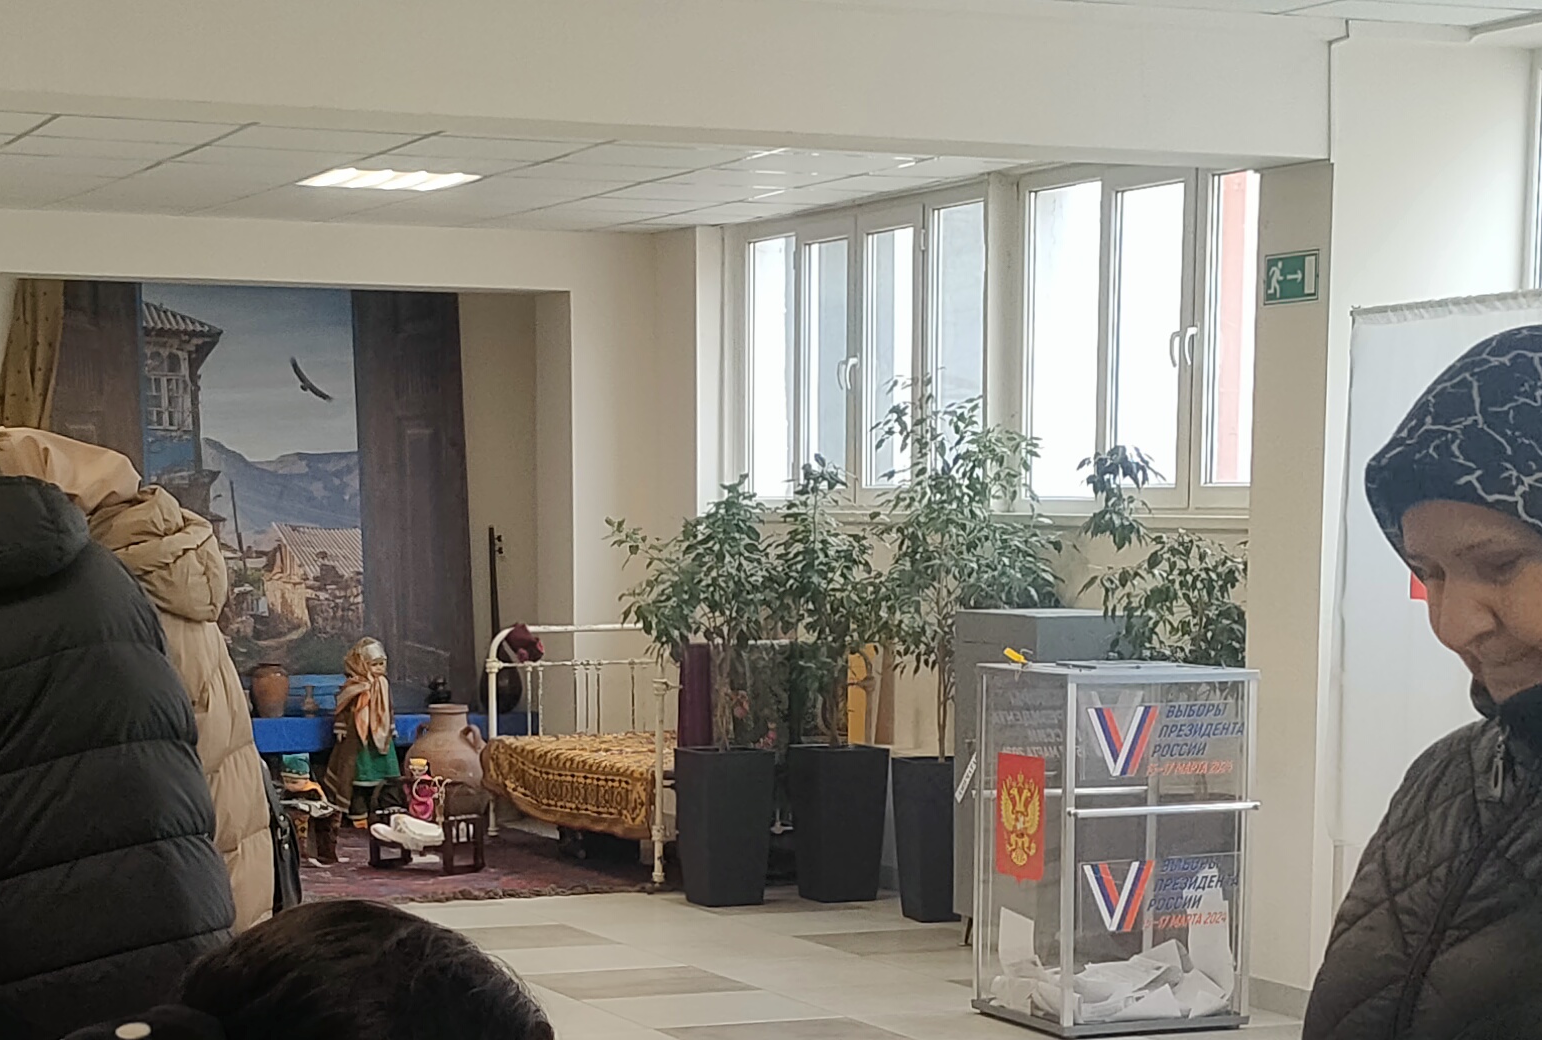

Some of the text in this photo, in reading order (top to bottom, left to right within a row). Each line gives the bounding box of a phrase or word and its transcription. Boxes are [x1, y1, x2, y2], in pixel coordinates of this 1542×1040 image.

[1165, 703, 1228, 719] ВЫБОРЫ
[1157, 722, 1245, 739] ПРЕЗИДЕНТА
[1151, 743, 1207, 758] РОССИИ
[1174, 760, 1208, 775] МАРТА
[1147, 895, 1203, 911] РОССИИ
[1170, 913, 1202, 927] МАРТА
[1203, 912, 1227, 925] 2024
